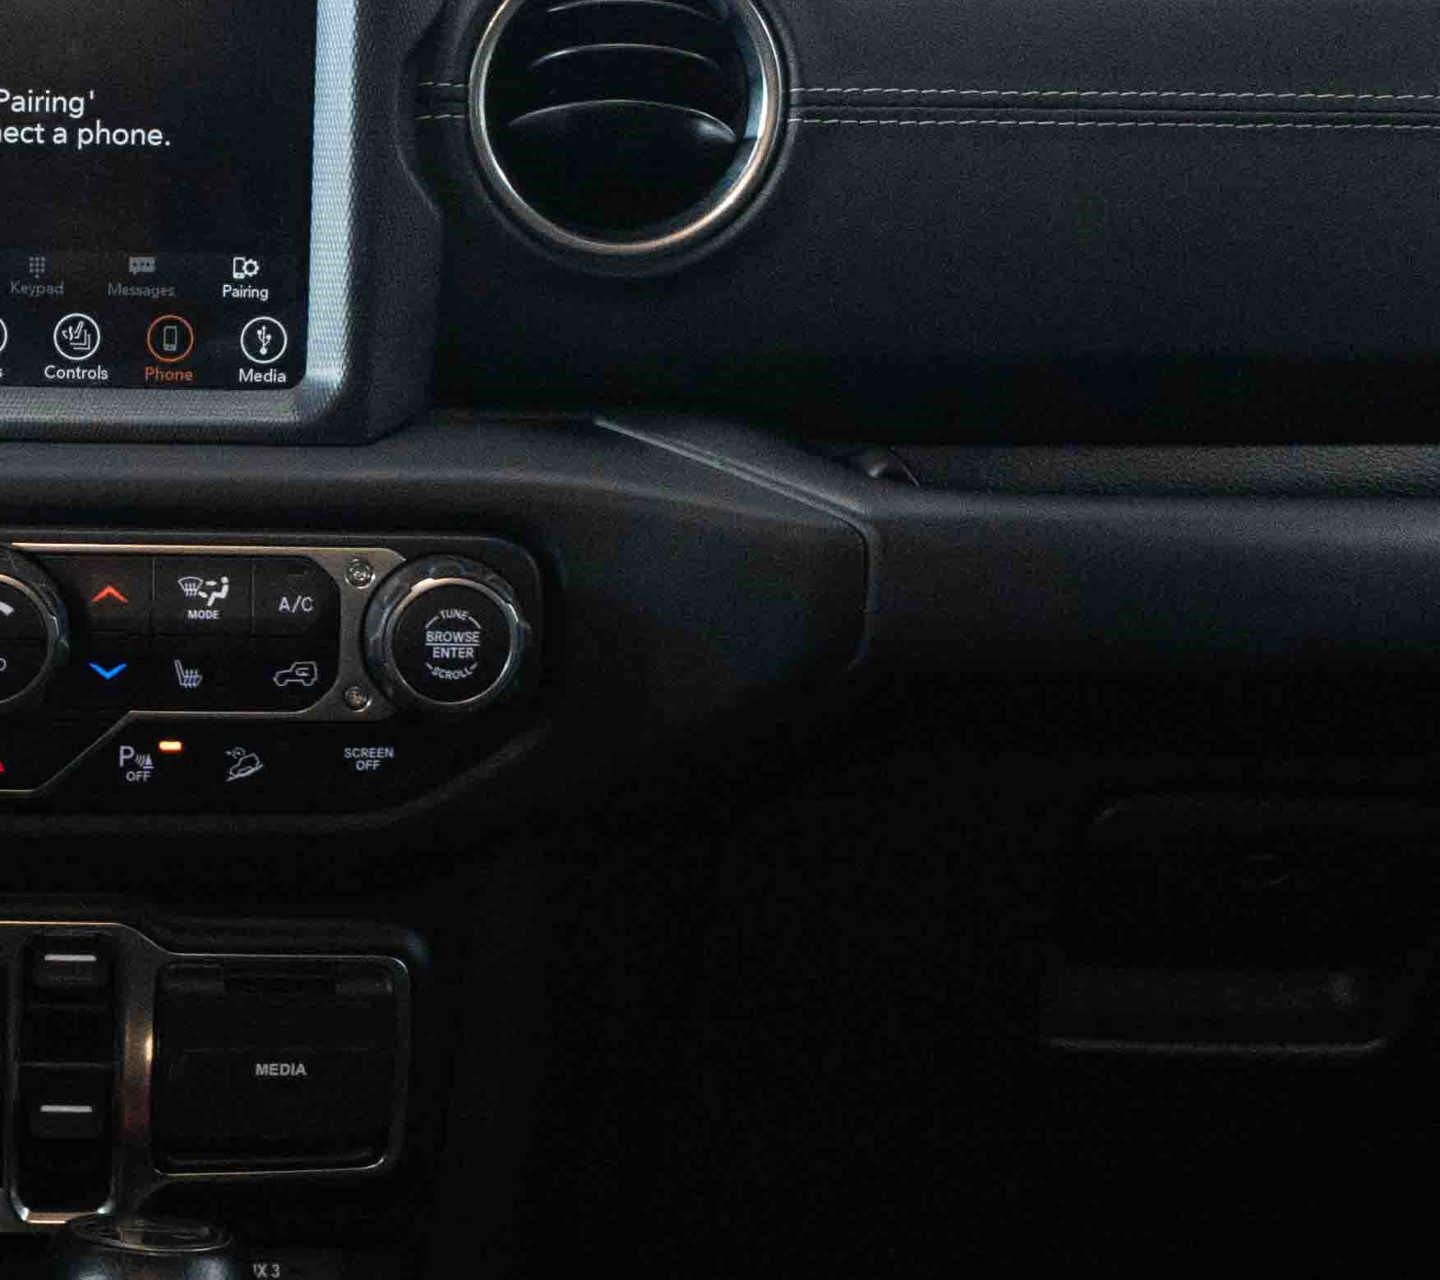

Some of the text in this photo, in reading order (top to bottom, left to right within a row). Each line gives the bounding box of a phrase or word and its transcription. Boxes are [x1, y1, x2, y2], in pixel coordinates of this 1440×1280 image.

[53, 127, 67, 144] a
[78, 120, 170, 149] phone.
[10, 280, 65, 297] Keypad
[108, 283, 176, 298] Messages
[222, 284, 269, 301] Pairing
[44, 365, 109, 381] Controls
[144, 366, 193, 382] Phone
[239, 368, 286, 382] Media
[279, 596, 313, 613] A/C
[187, 608, 220, 620] MODE
[439, 608, 469, 622] TUNE
[425, 630, 481, 644] BROWSE
[432, 646, 475, 659] ENTER
[431, 665, 474, 680] SCROLL
[344, 747, 395, 760] SCREEN
[356, 760, 381, 771] OFF
[126, 771, 152, 782] OFF
[256, 1063, 306, 1076] MEDIA
